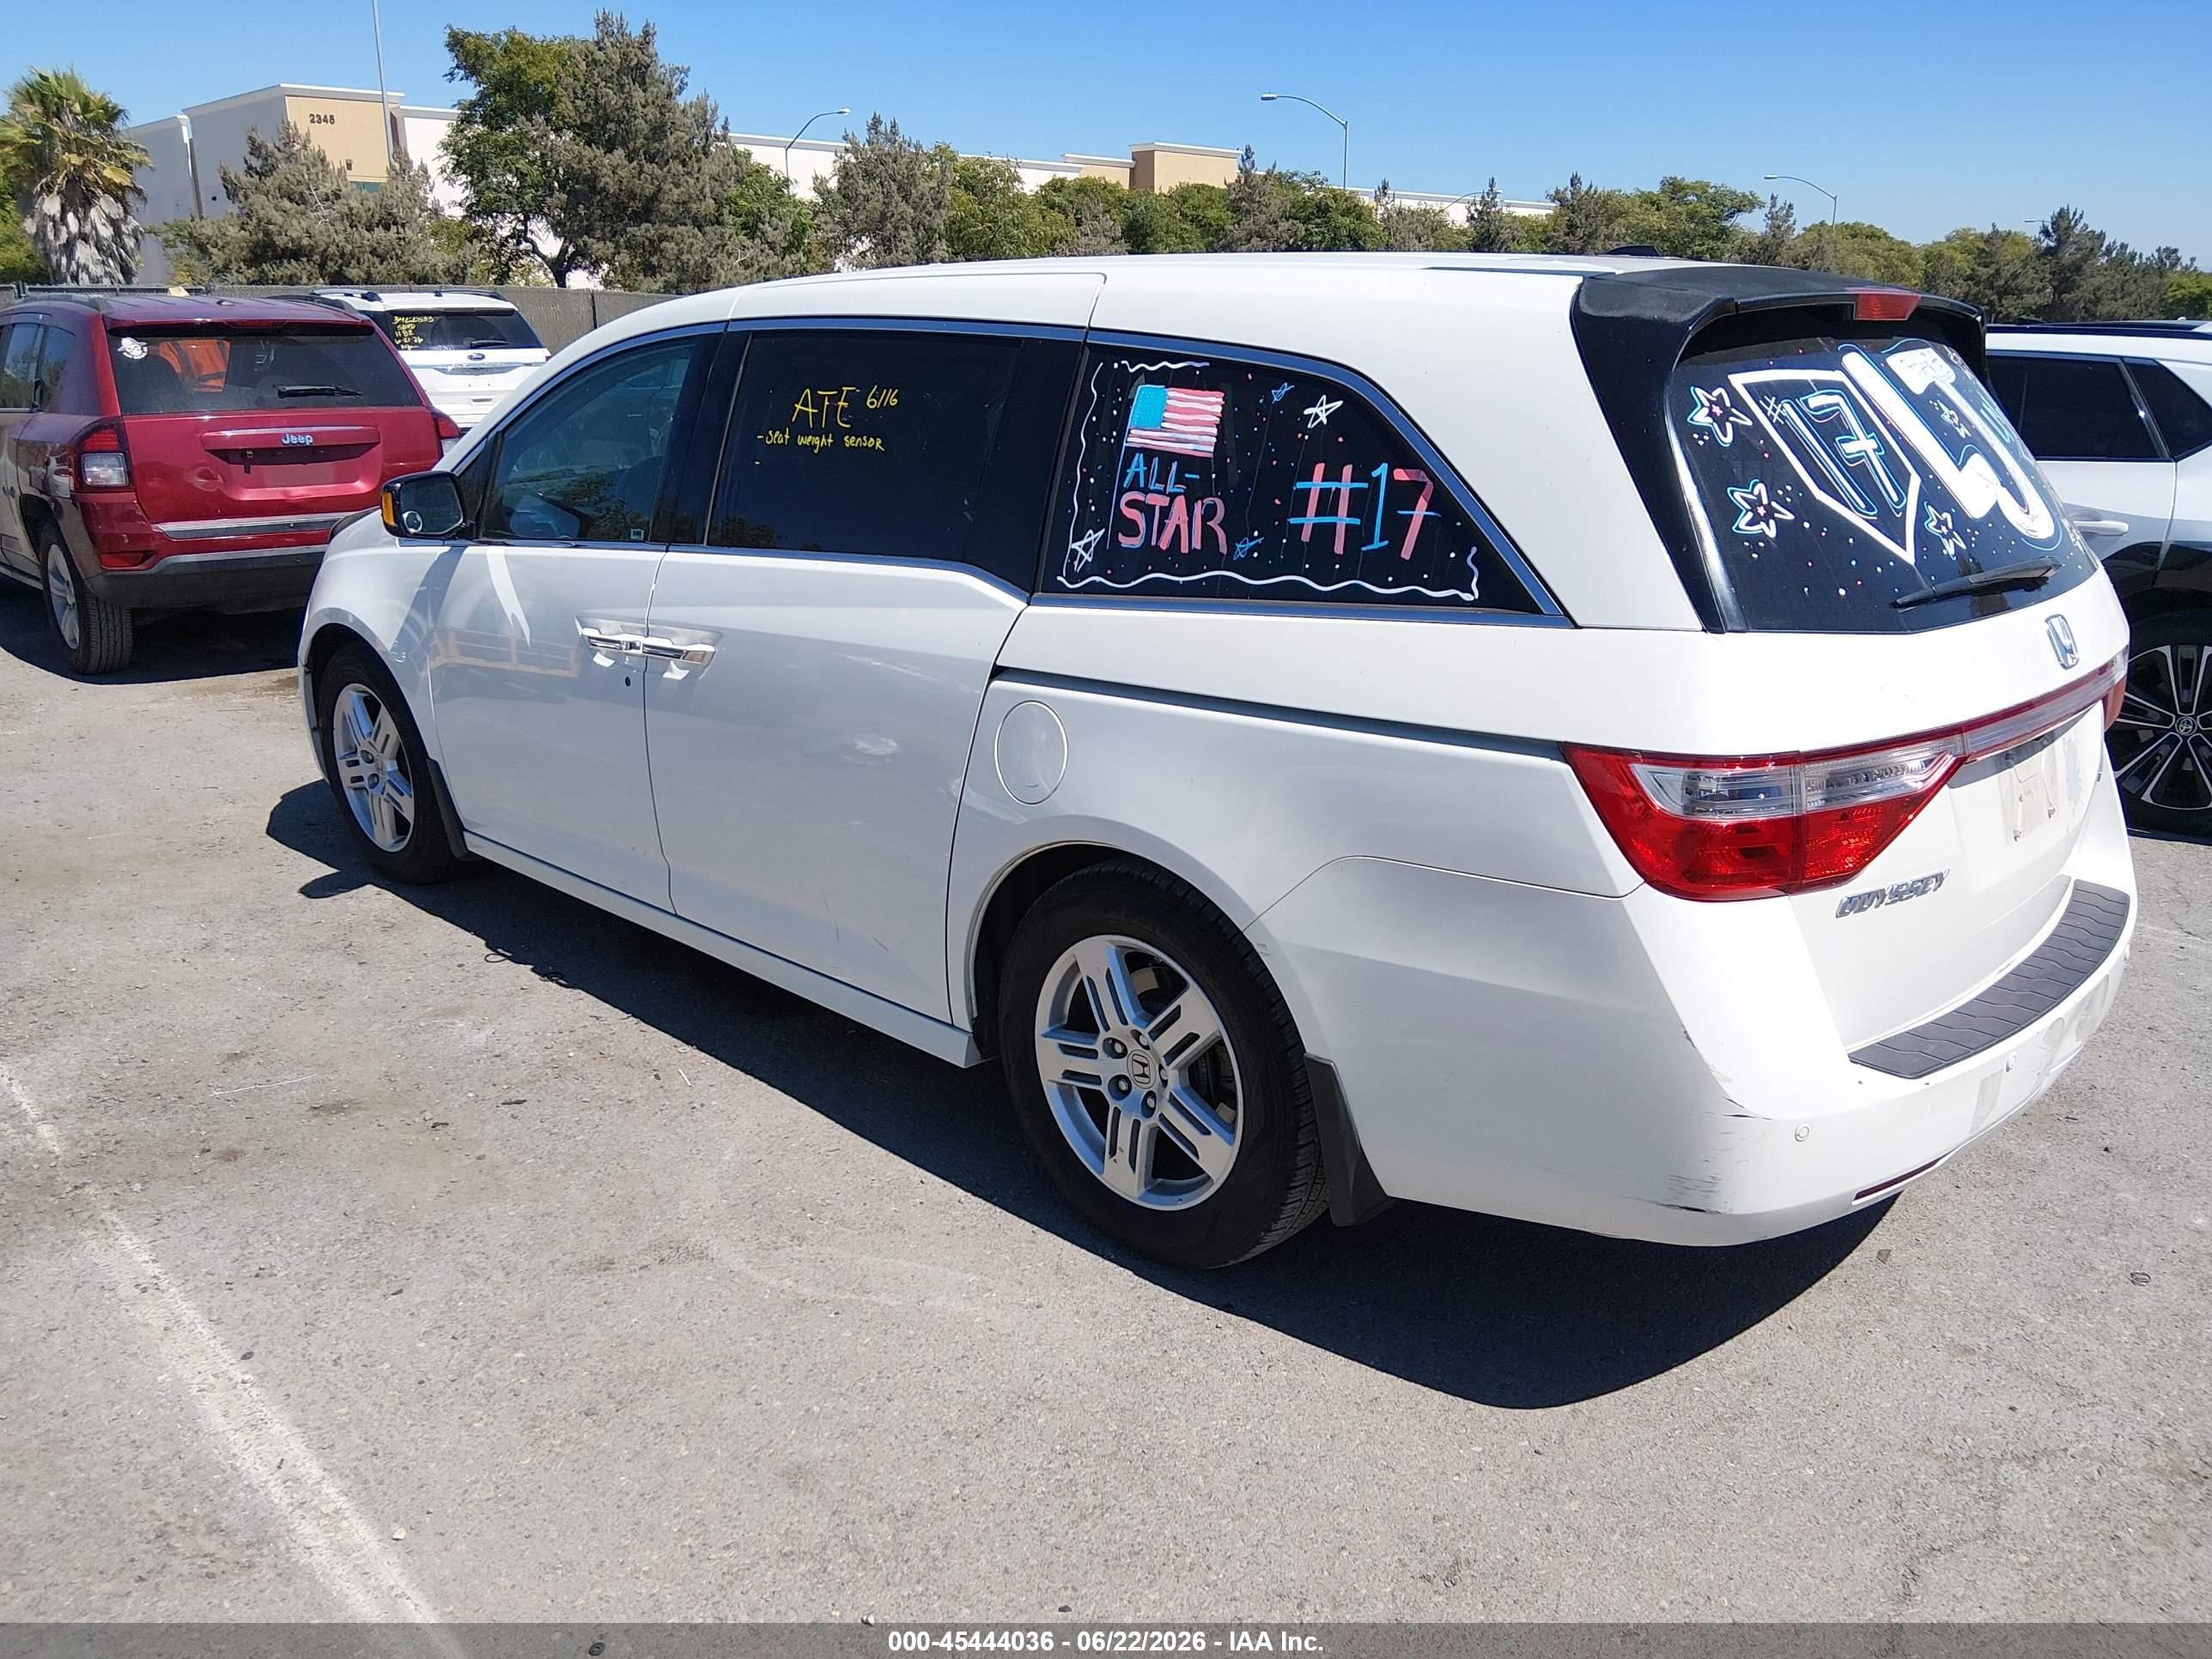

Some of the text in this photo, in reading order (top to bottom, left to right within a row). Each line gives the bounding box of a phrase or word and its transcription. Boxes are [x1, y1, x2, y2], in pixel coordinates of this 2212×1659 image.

[308, 113, 336, 125] 2345
[281, 433, 313, 446] Jeep
[797, 433, 834, 453] weight
[1123, 453, 1200, 494] ALL-
[1118, 490, 1228, 556] STAR
[1289, 462, 1442, 561] #17
[1835, 868, 1951, 919] ODYSSEY
